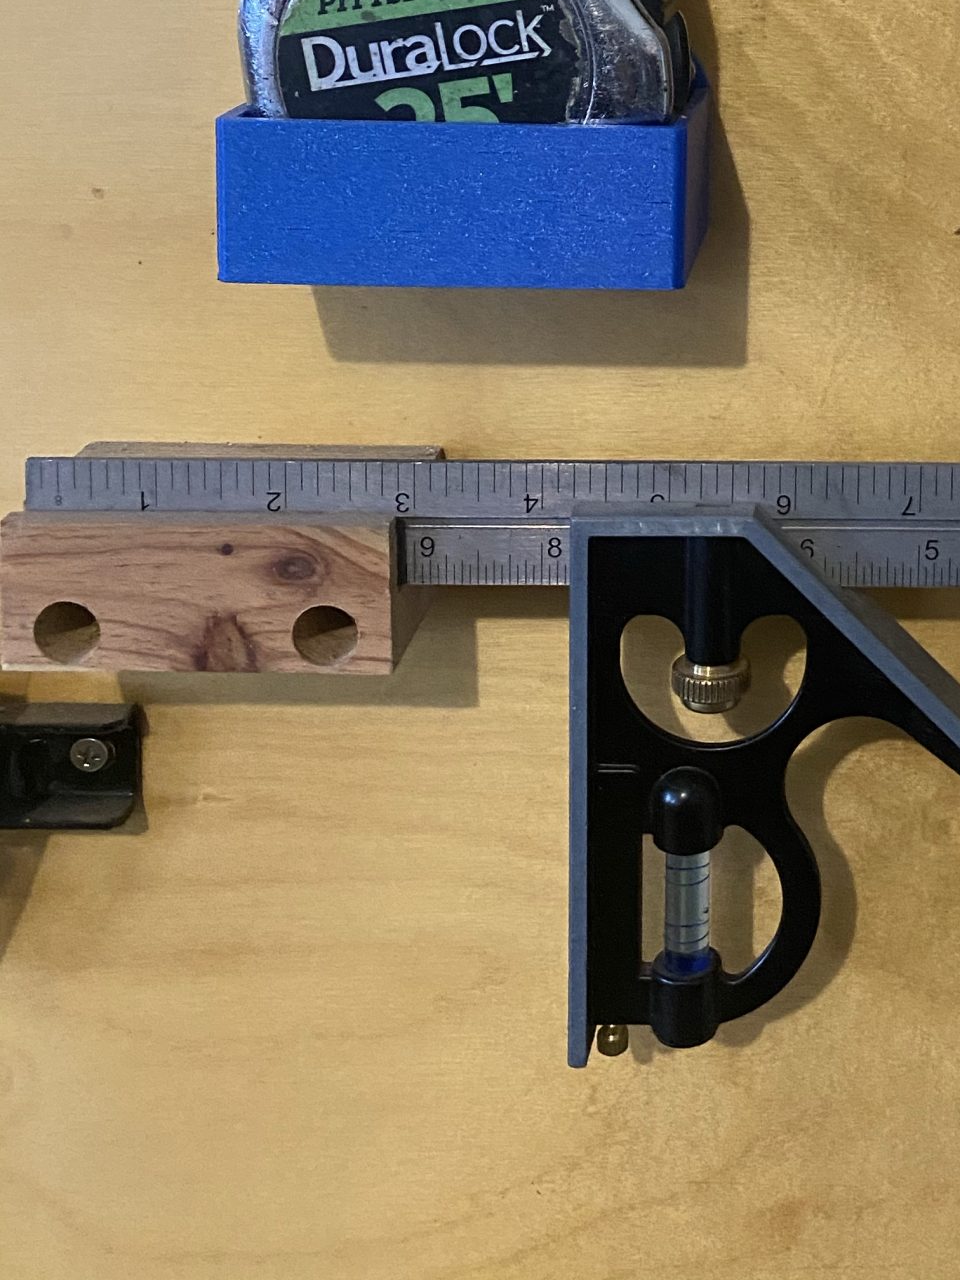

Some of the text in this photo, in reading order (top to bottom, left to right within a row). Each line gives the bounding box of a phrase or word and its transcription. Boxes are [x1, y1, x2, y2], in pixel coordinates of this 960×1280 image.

[140, 491, 151, 511] 1
[266, 492, 282, 513] 2
[395, 493, 410, 513] 3
[523, 493, 539, 514] 4
[901, 495, 916, 517] 7
[419, 536, 435, 558] 9
[547, 537, 562, 558] 8
[924, 539, 939, 561] 5
